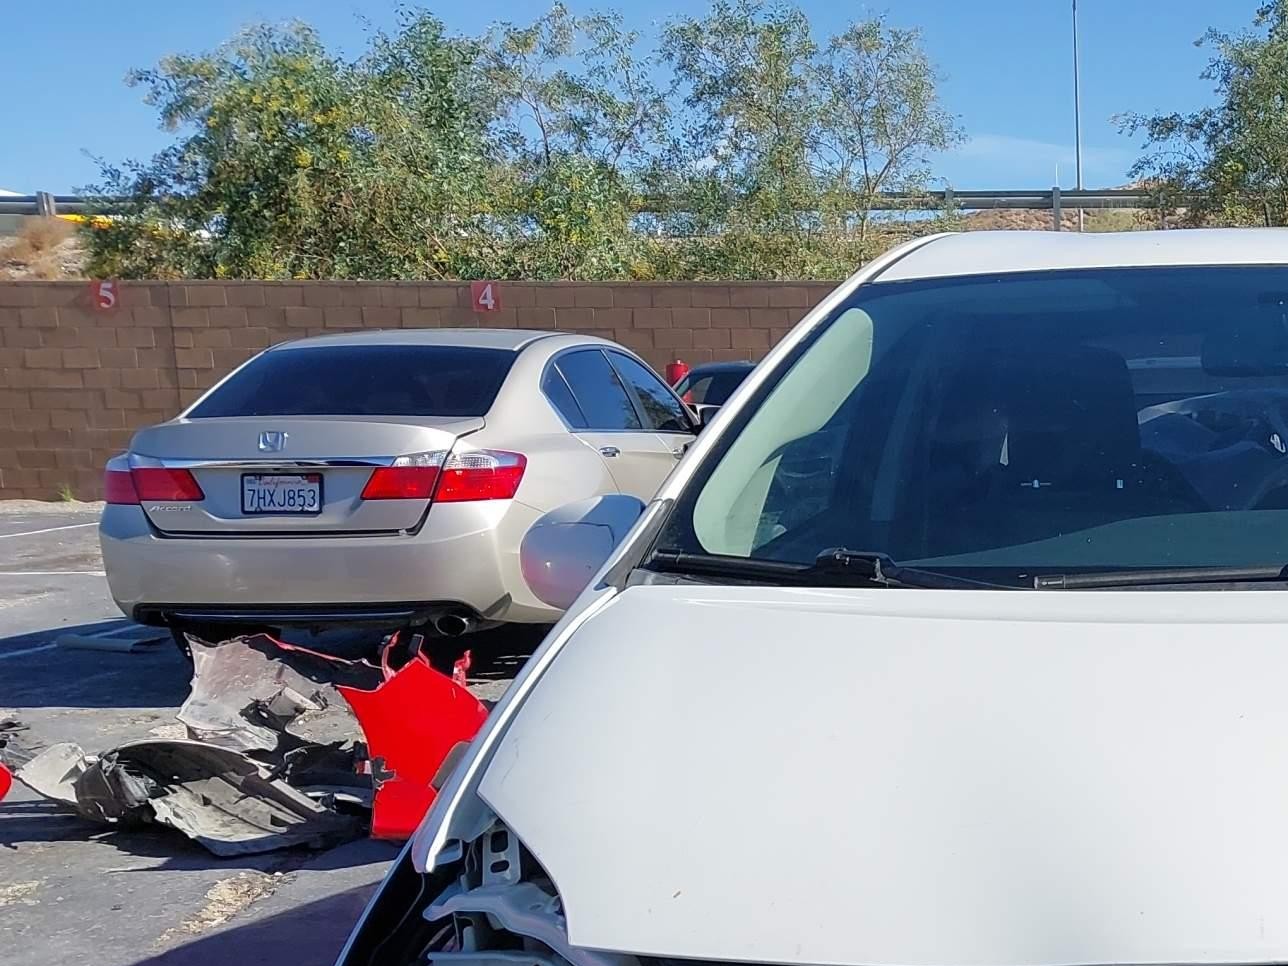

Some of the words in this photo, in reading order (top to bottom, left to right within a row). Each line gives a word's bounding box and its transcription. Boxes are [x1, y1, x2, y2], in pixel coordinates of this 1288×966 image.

[99, 282, 115, 308] 5
[478, 283, 495, 310] 4
[148, 504, 193, 512] Accord
[247, 488, 316, 507] 7HXJ853
